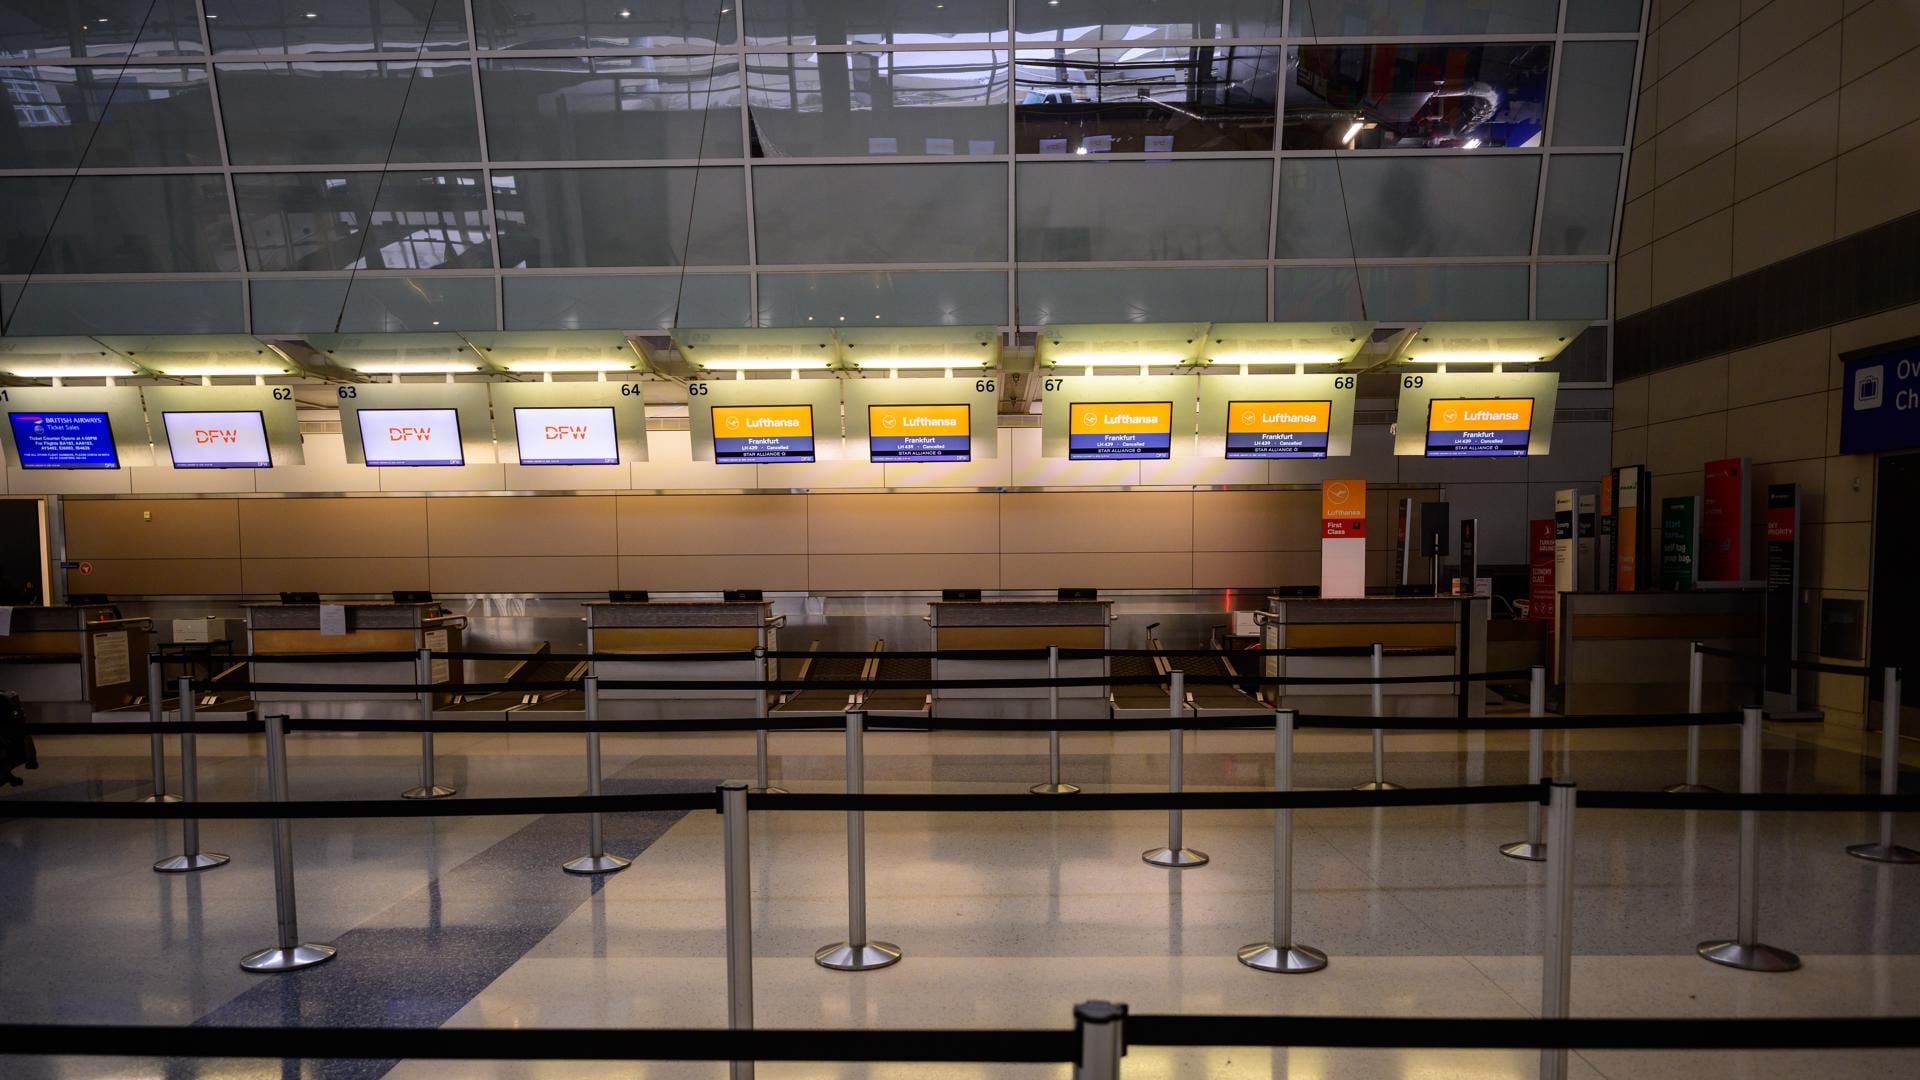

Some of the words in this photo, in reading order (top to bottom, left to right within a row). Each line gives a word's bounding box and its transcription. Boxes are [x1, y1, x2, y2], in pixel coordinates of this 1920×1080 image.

[975, 380, 995, 392] 66
[1045, 379, 1063, 391] 67
[1334, 377, 1354, 389] 68
[1404, 376, 1423, 388] 69
[272, 388, 292, 401] 62
[338, 386, 357, 398] 63
[621, 383, 641, 396] 64
[689, 383, 708, 396] 65
[0, 390, 8, 402] 1
[903, 416, 957, 427] Lufthansa
[1104, 413, 1158, 425] Lufthansa
[1262, 413, 1317, 423] Lufthansa
[1463, 410, 1519, 421] Lufthansa
[746, 417, 800, 428] Lufthansa
[195, 430, 237, 444] DFW
[389, 427, 431, 441] DFW
[545, 426, 587, 439] DFW
[1768, 528, 1793, 536] PRIORITY
